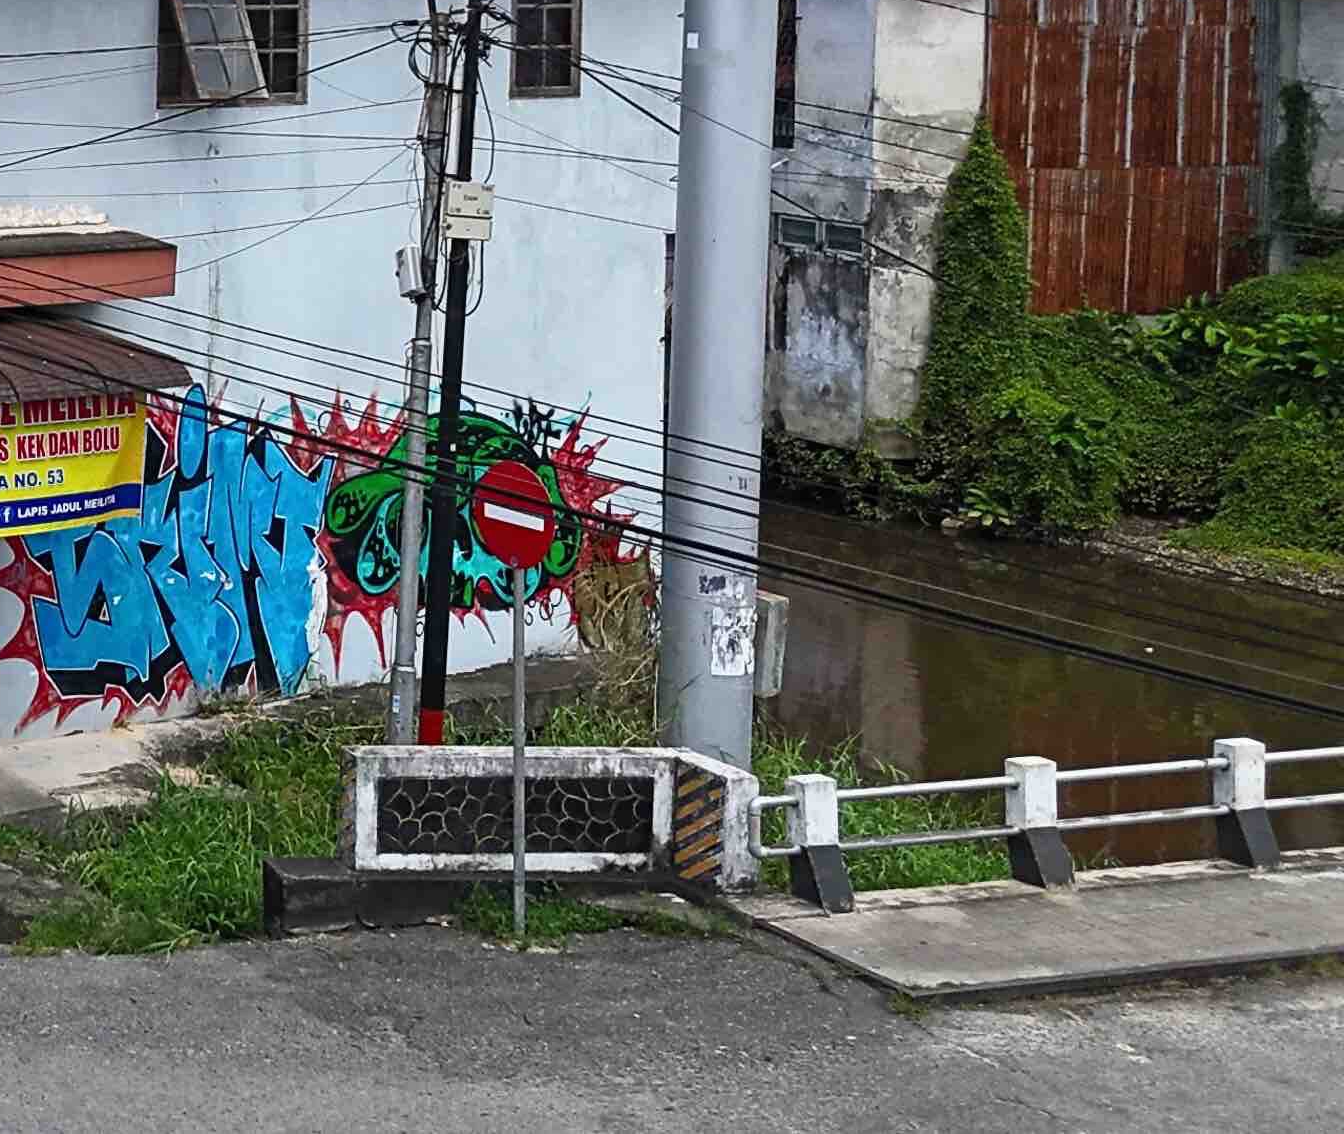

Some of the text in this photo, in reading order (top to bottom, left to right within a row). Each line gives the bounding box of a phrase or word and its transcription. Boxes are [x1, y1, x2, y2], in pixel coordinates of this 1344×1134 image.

[17, 433, 46, 459] KEK
[48, 430, 79, 456] DAN
[83, 426, 120, 453] BOLU
[14, 472, 42, 488] NO.
[47, 469, 63, 484] 53
[17, 506, 48, 518] LAPIS
[50, 502, 82, 514] JADUL
